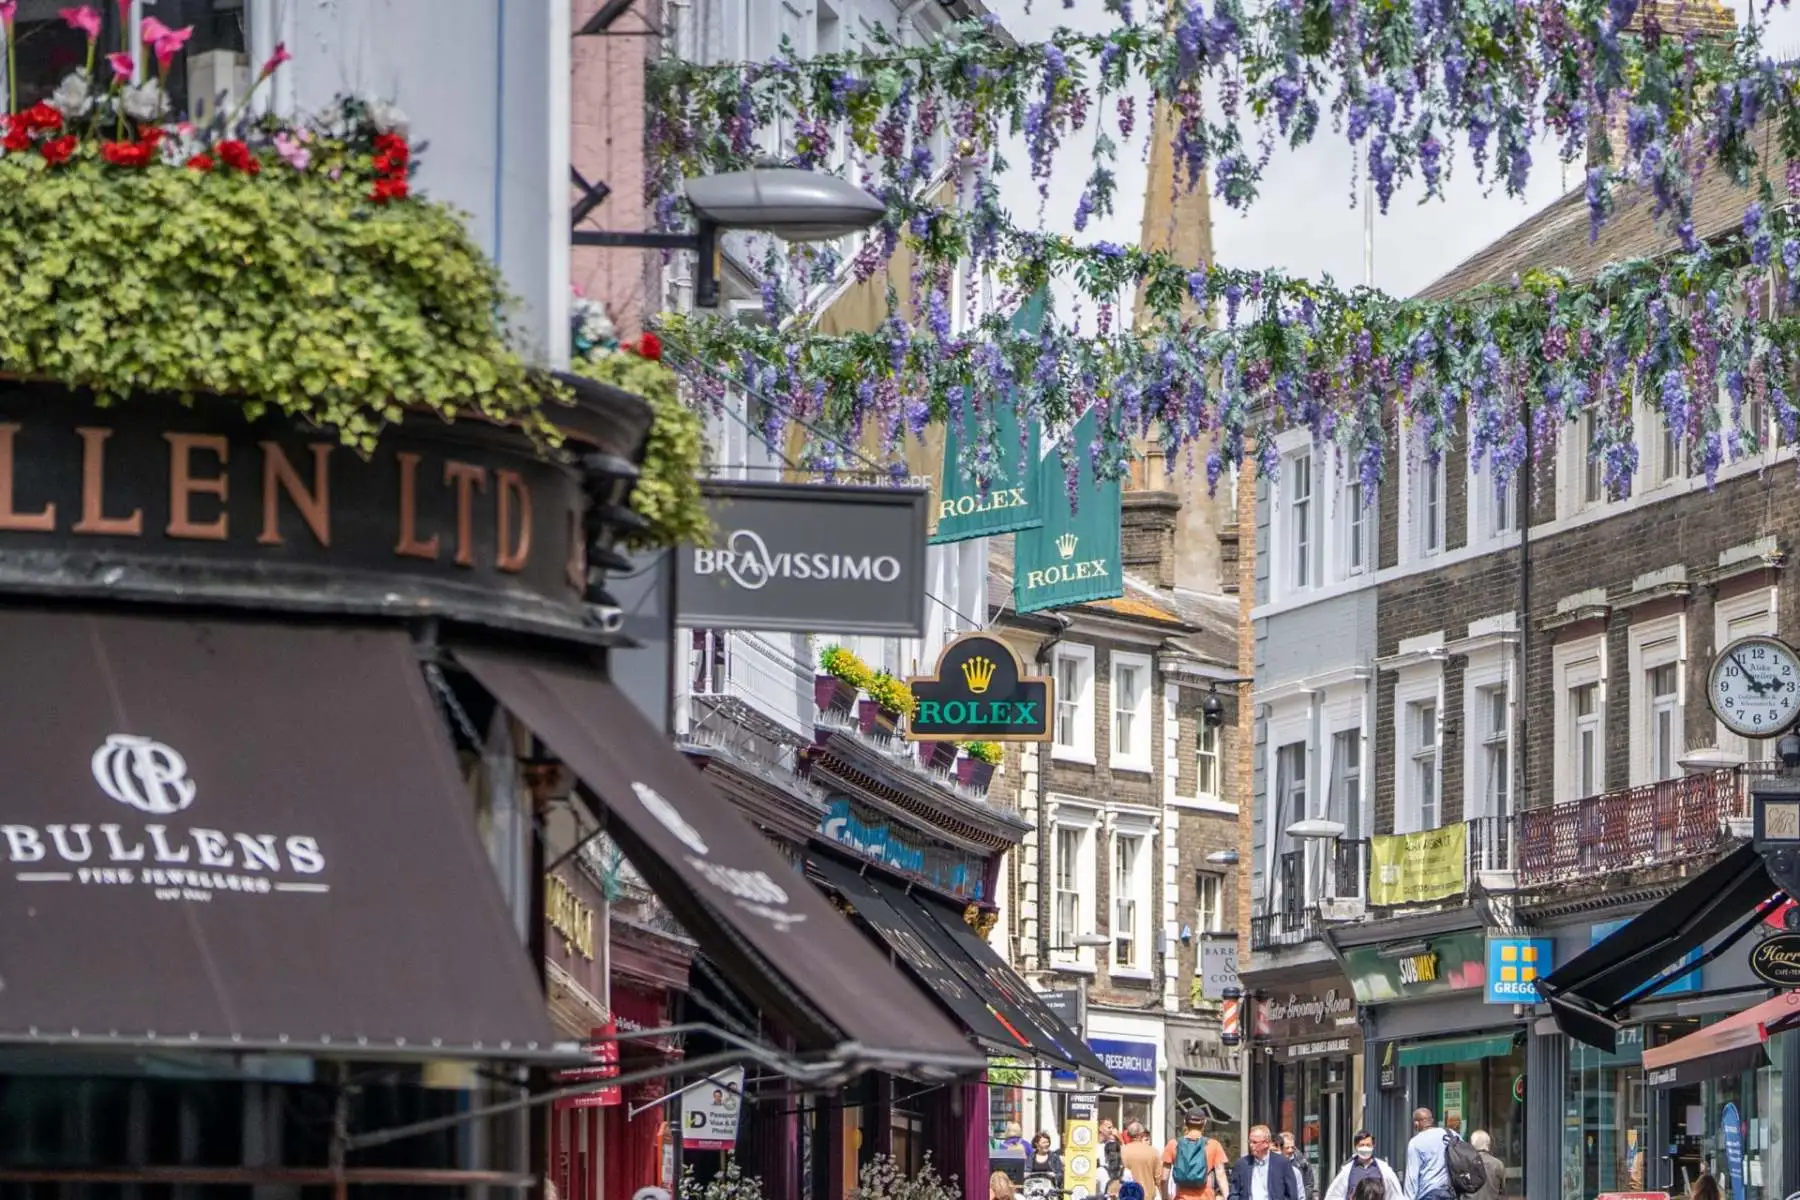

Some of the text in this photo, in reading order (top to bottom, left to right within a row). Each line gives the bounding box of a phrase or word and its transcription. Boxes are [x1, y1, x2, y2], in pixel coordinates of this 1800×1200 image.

[939, 487, 1029, 519] ROLEX
[395, 453, 532, 573] LTD
[694, 530, 900, 589] BRAVISSIMO
[1027, 559, 1109, 589] ROLEX
[1752, 648, 1765, 659] 12
[1773, 655, 1779, 664] 1
[1726, 666, 1739, 677] 10
[1782, 665, 1791, 675] 2
[1720, 681, 1729, 692] 9
[1786, 682, 1795, 692] 3
[1725, 697, 1734, 708] 8
[1781, 697, 1789, 707] 4
[918, 701, 1038, 724] ROLEX
[1736, 710, 1745, 720] 7
[1769, 710, 1777, 720] 5
[1753, 714, 1762, 724] 6
[1, 824, 325, 874] BULLENS
[1205, 947, 1238, 956] BARR
[1223, 957, 1236, 973] &
[1400, 953, 1437, 984] SUBWAY
[1495, 982, 1537, 993] GREGG
[1287, 993, 1324, 1024] Grooming
[1324, 989, 1350, 1013] Room
[1327, 1038, 1350, 1051] AVAILABLE
[1105, 1054, 1141, 1071] RESEARCH
[1143, 1057, 1152, 1072] UK
